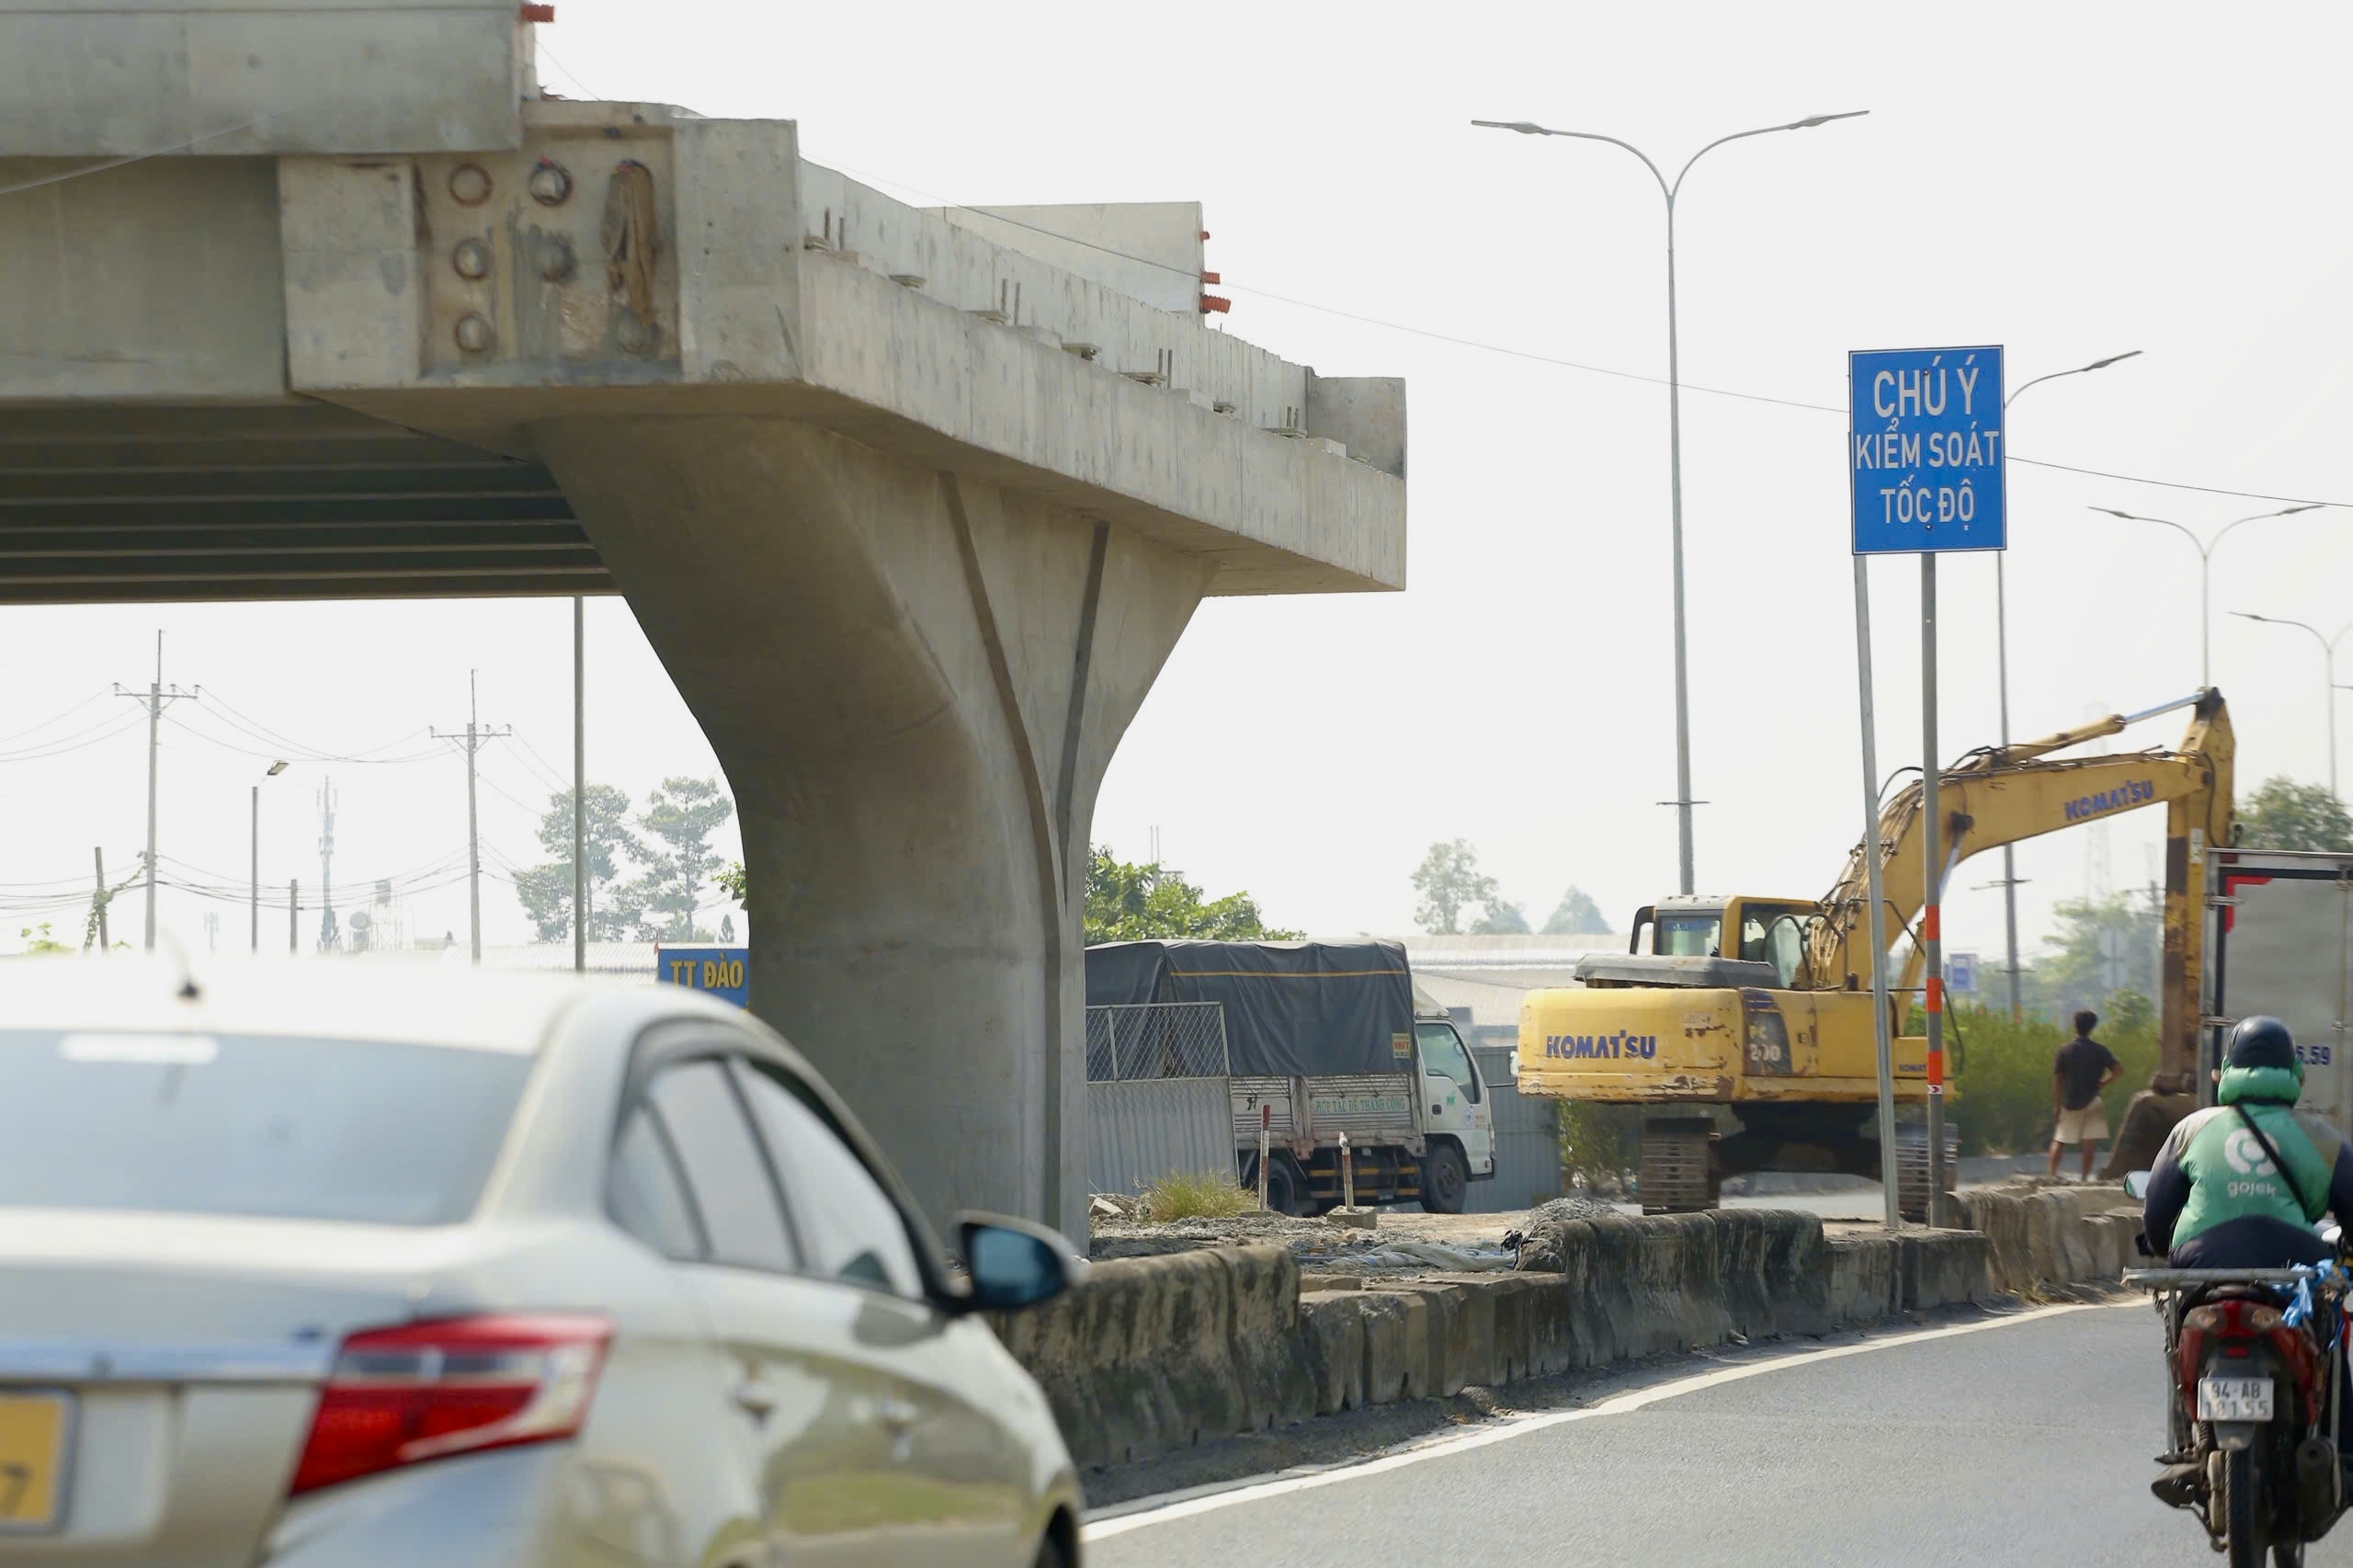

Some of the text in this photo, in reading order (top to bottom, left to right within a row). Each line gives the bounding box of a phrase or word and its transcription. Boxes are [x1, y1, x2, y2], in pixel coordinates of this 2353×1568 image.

[1873, 354, 1979, 418] CHÚ Ý
[1856, 416, 2000, 470] KIỂM SOÁT
[1880, 473, 1975, 531] TỐC ĐỘ
[2063, 779, 2154, 821] KOMATSU
[670, 952, 744, 989] TT ĐÀO
[1546, 1029, 1655, 1059] KOMATSU
[2227, 1181, 2278, 1198] gojek
